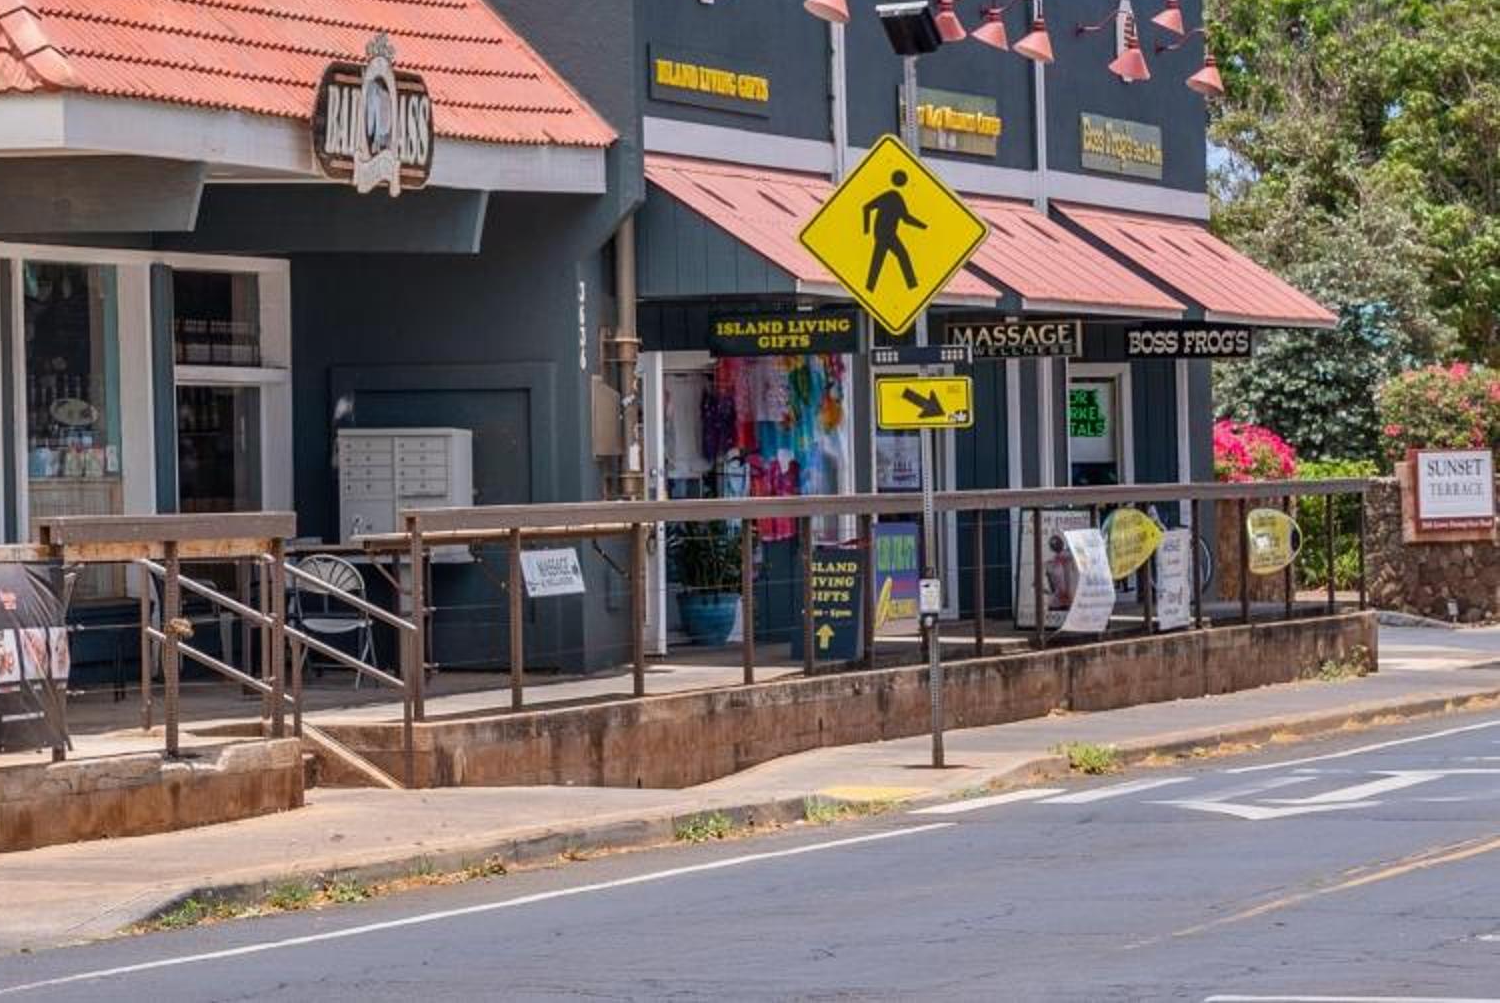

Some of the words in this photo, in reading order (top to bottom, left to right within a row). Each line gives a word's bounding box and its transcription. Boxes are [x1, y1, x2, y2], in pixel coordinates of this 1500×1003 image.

[716, 320, 784, 336] ISLAND
[787, 319, 851, 334] LIVING
[953, 324, 1072, 346] MASSAGE
[757, 335, 811, 349] GIFTS
[1127, 330, 1179, 354] BOSS
[1427, 458, 1484, 476] SUNSET
[811, 562, 858, 574] SLAND
[811, 576, 856, 589] IVING
